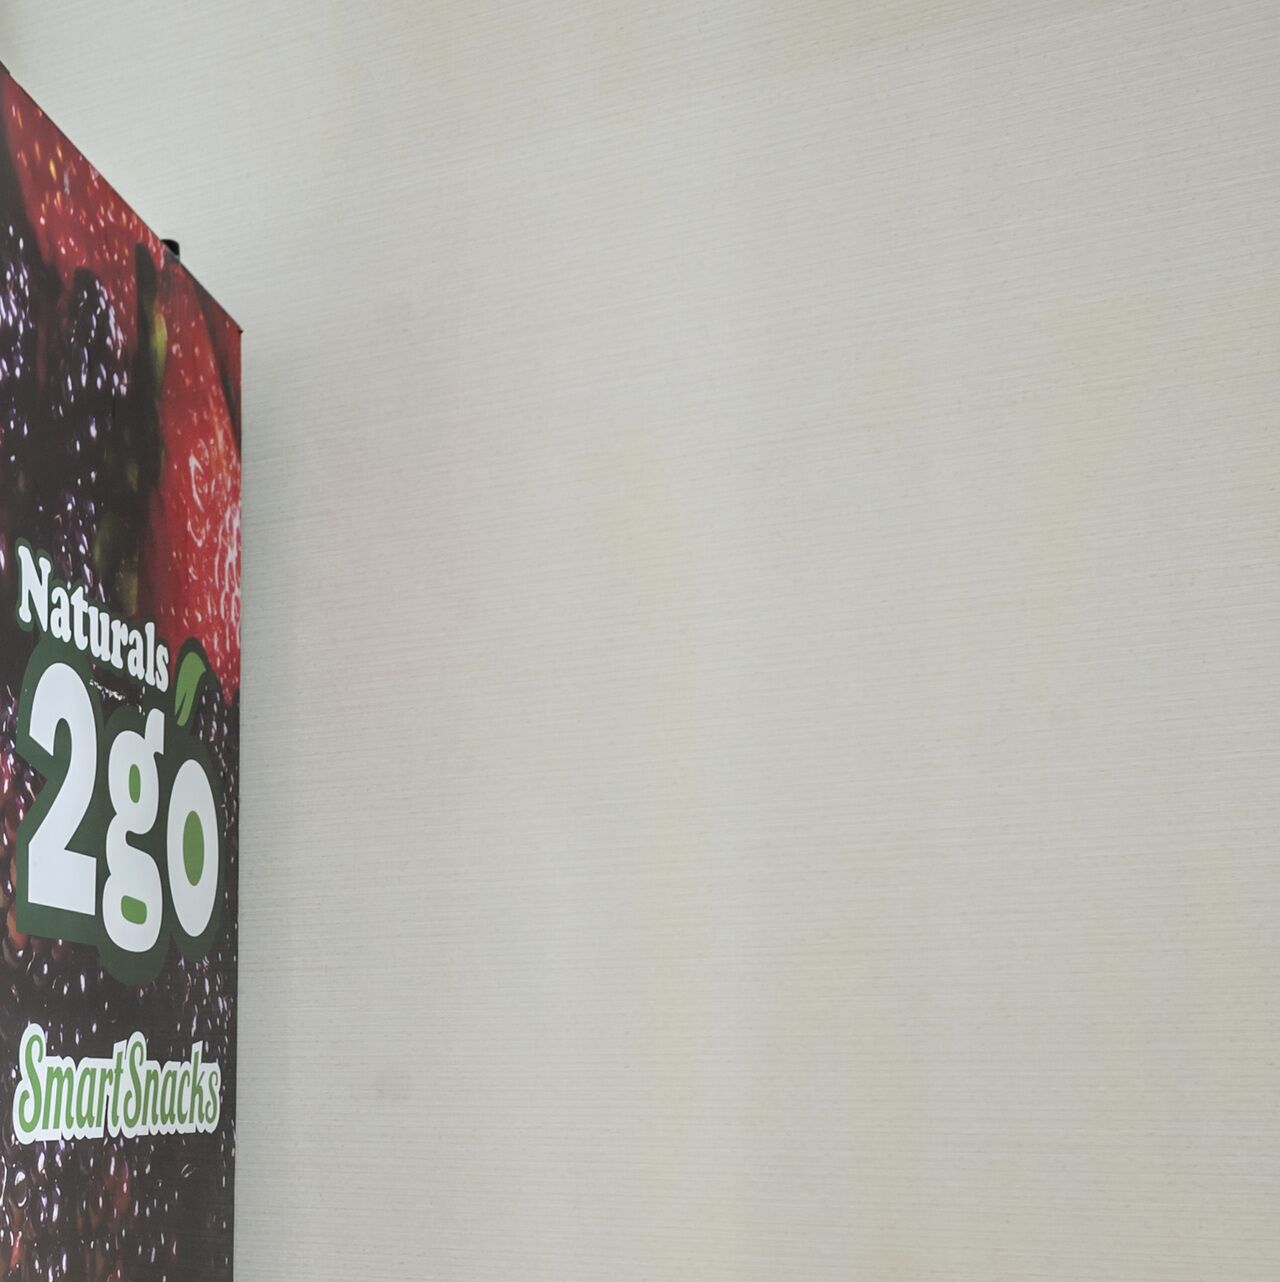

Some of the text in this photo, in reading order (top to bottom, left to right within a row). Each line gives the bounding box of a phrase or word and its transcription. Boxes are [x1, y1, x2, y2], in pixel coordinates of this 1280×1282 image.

[16, 544, 169, 694] Naturals
[26, 661, 219, 953] 2go
[16, 1028, 218, 1136] SmartSnacks
